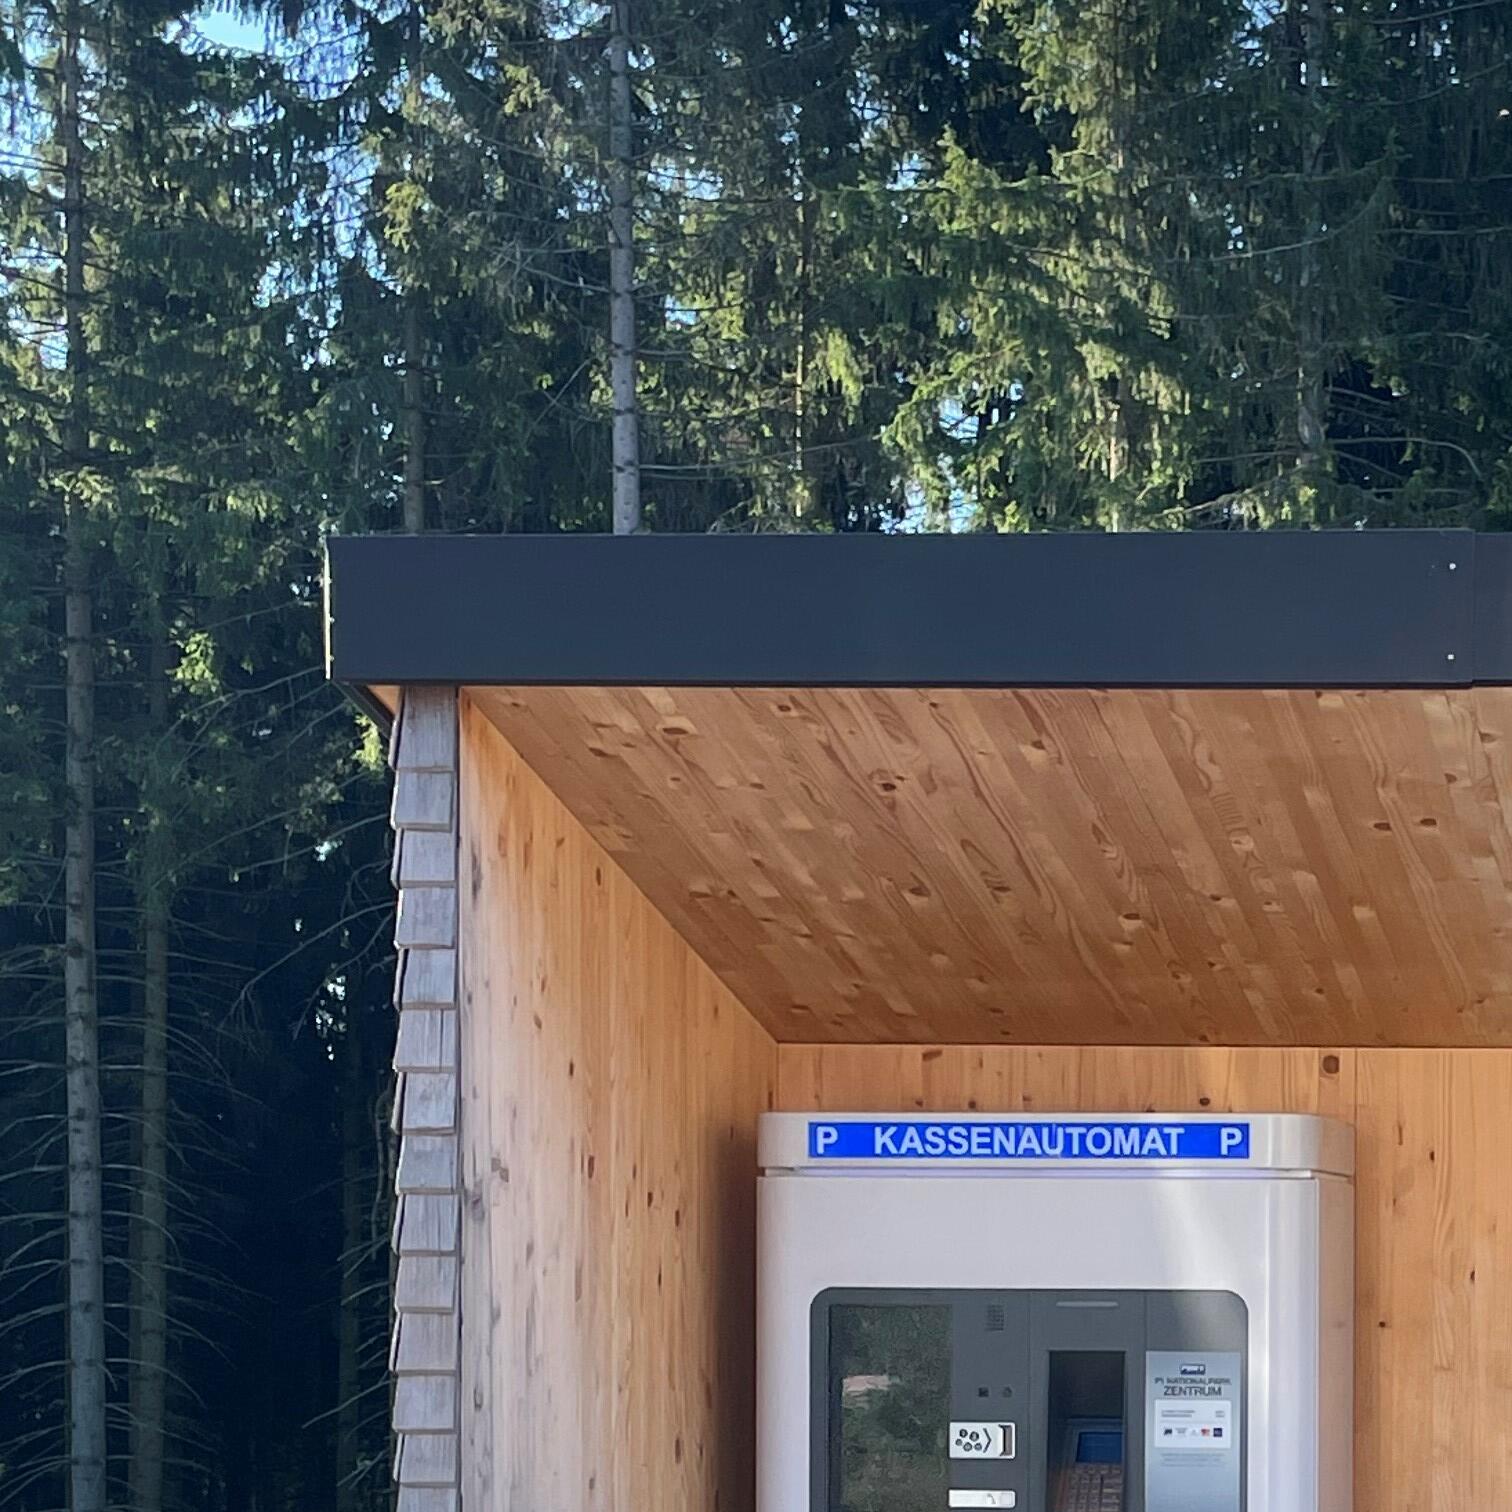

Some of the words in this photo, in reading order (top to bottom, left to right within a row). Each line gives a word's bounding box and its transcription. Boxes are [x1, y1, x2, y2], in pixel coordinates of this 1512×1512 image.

[816, 1126, 839, 1153] P
[874, 1126, 1186, 1157] KASSENAUTOMAT
[1220, 1127, 1243, 1155] P
[1163, 1385, 1222, 1396] ZENTRUM
